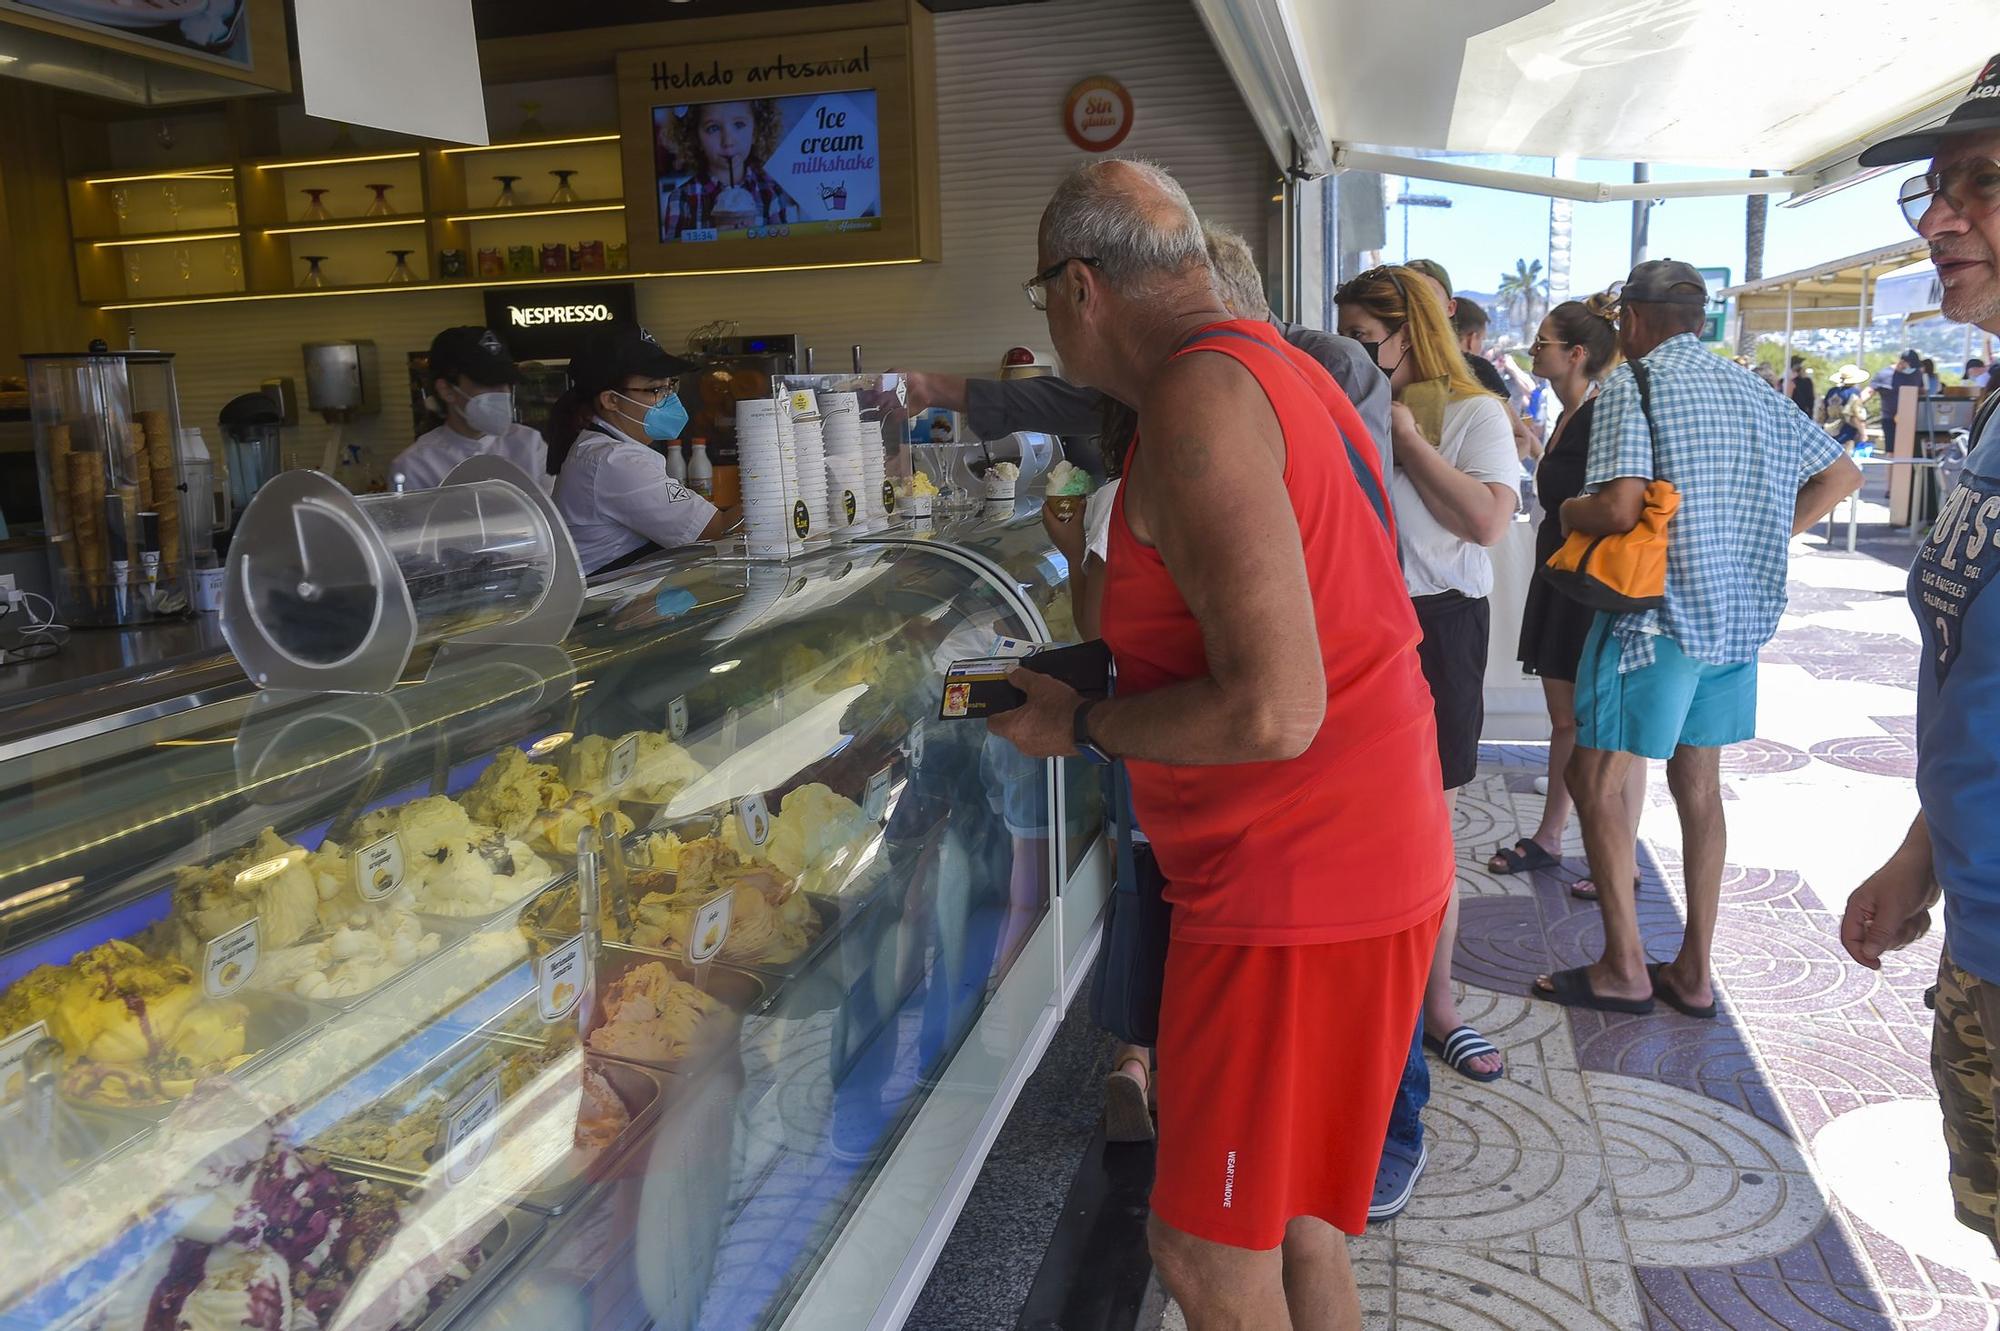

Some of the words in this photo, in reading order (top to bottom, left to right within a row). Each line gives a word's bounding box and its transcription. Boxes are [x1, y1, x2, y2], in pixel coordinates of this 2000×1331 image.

[651, 61, 733, 91] Helado
[747, 46, 870, 83] artesanal
[816, 106, 846, 130] Ice
[801, 134, 864, 154] cream
[792, 154, 875, 175] milkshake
[507, 304, 608, 328] NESPRESSO
[1935, 575, 1968, 599] ANGELES
